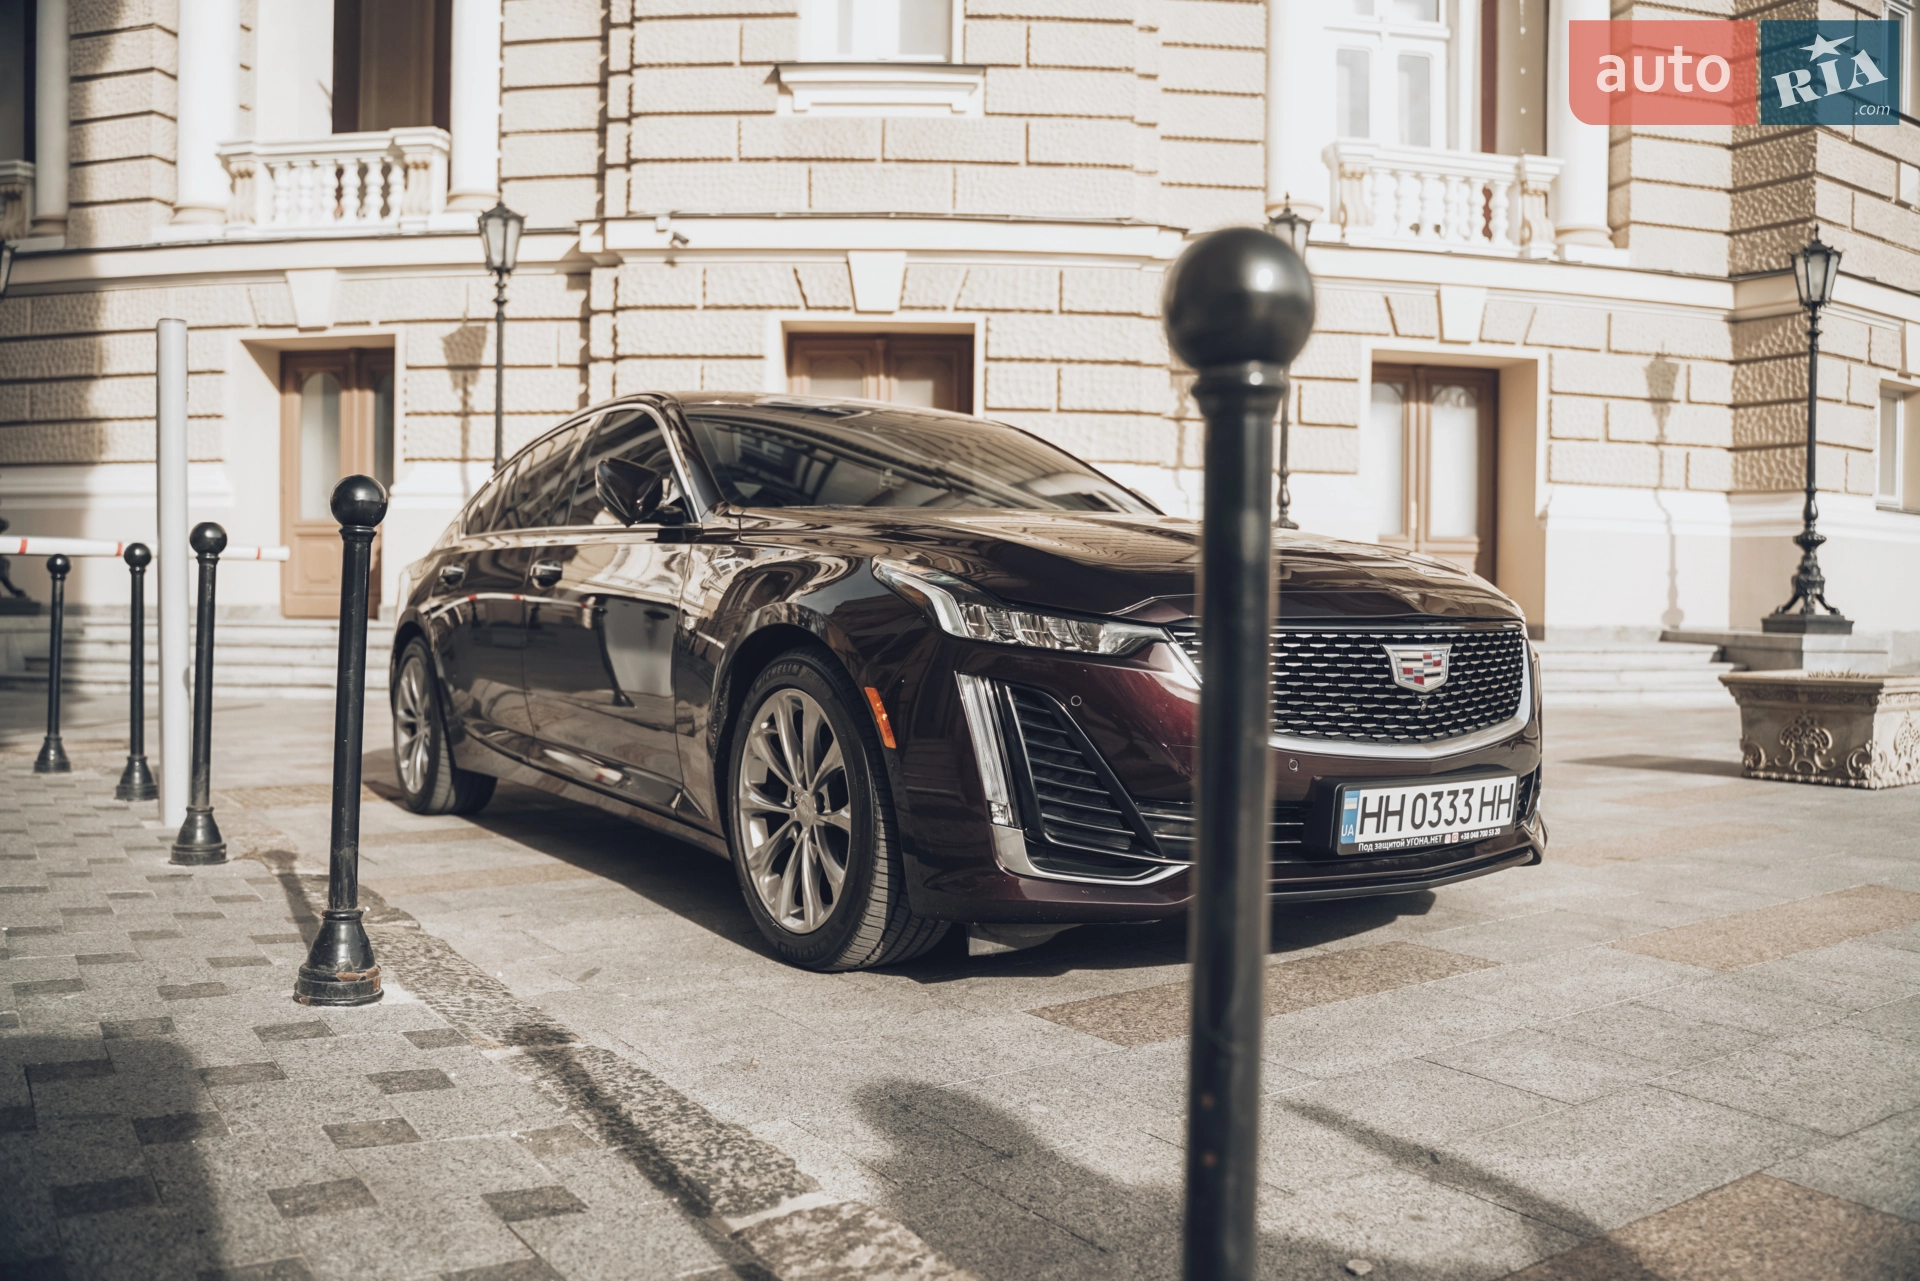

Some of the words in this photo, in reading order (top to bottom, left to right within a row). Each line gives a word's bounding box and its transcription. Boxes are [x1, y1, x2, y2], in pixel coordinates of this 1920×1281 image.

[756, 663, 800, 690] MICHELIN
[1359, 794, 1406, 835] HH
[1411, 788, 1474, 830] 0333
[1478, 783, 1514, 823] HH
[1341, 824, 1355, 837] UA
[1358, 842, 1374, 853] Под
[1374, 839, 1405, 851] защитой
